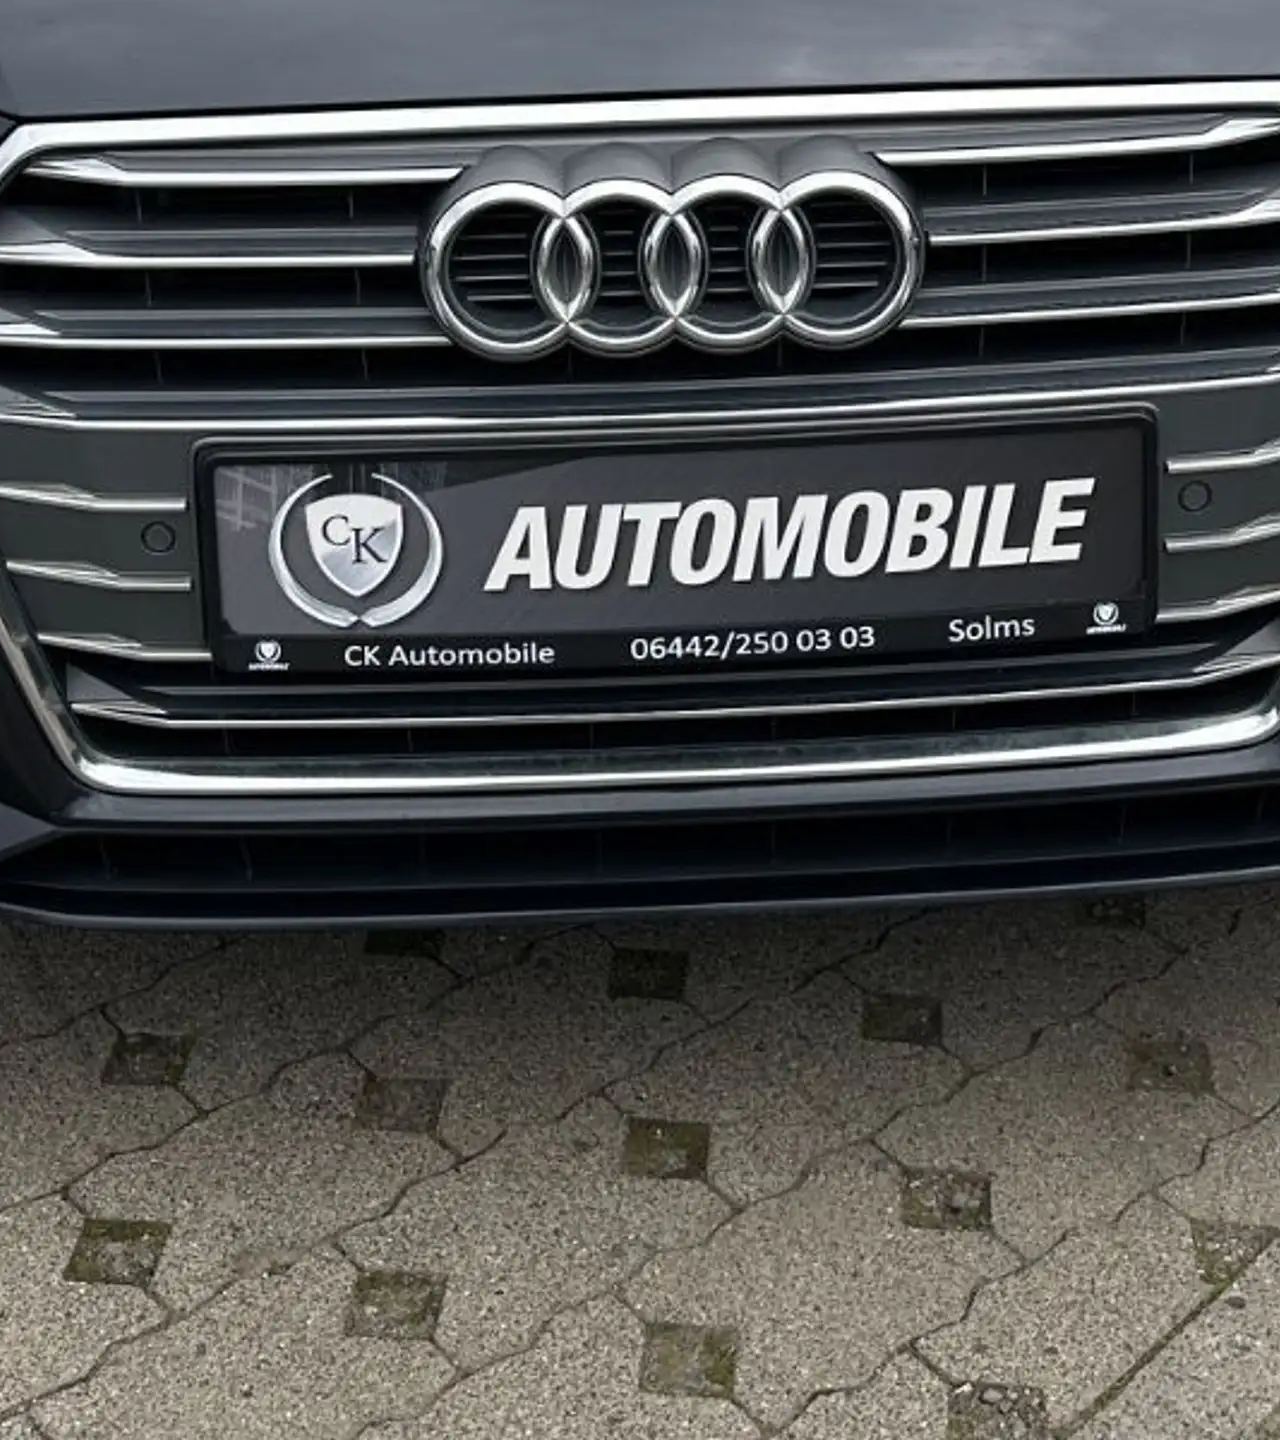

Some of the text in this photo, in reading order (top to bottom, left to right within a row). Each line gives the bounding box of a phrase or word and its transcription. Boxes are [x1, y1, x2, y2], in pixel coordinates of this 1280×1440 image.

[322, 513, 388, 565] CK
[483, 477, 1096, 592] AUTOMOBILE
[344, 614, 1036, 667] CK Automobile 06442/250 03 03 Solms
